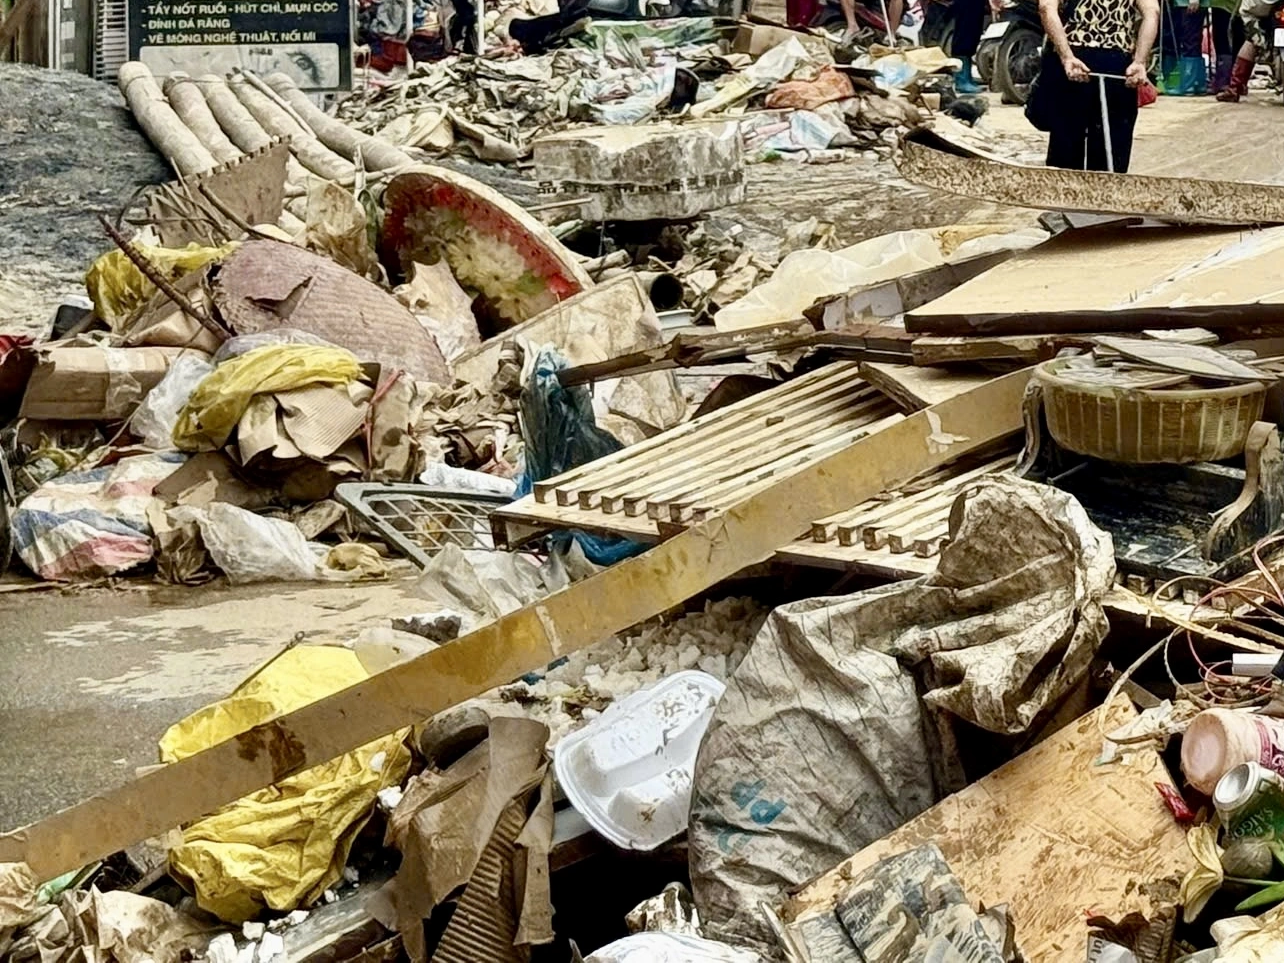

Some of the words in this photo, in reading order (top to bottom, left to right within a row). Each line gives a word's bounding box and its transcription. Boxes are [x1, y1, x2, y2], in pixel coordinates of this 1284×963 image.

[172, 2, 197, 15] NỐT
[148, 18, 176, 30] ĐÍNH
[178, 18, 194, 29] ĐÁ
[197, 17, 230, 29] RĂNG
[166, 32, 201, 44] MÓNG
